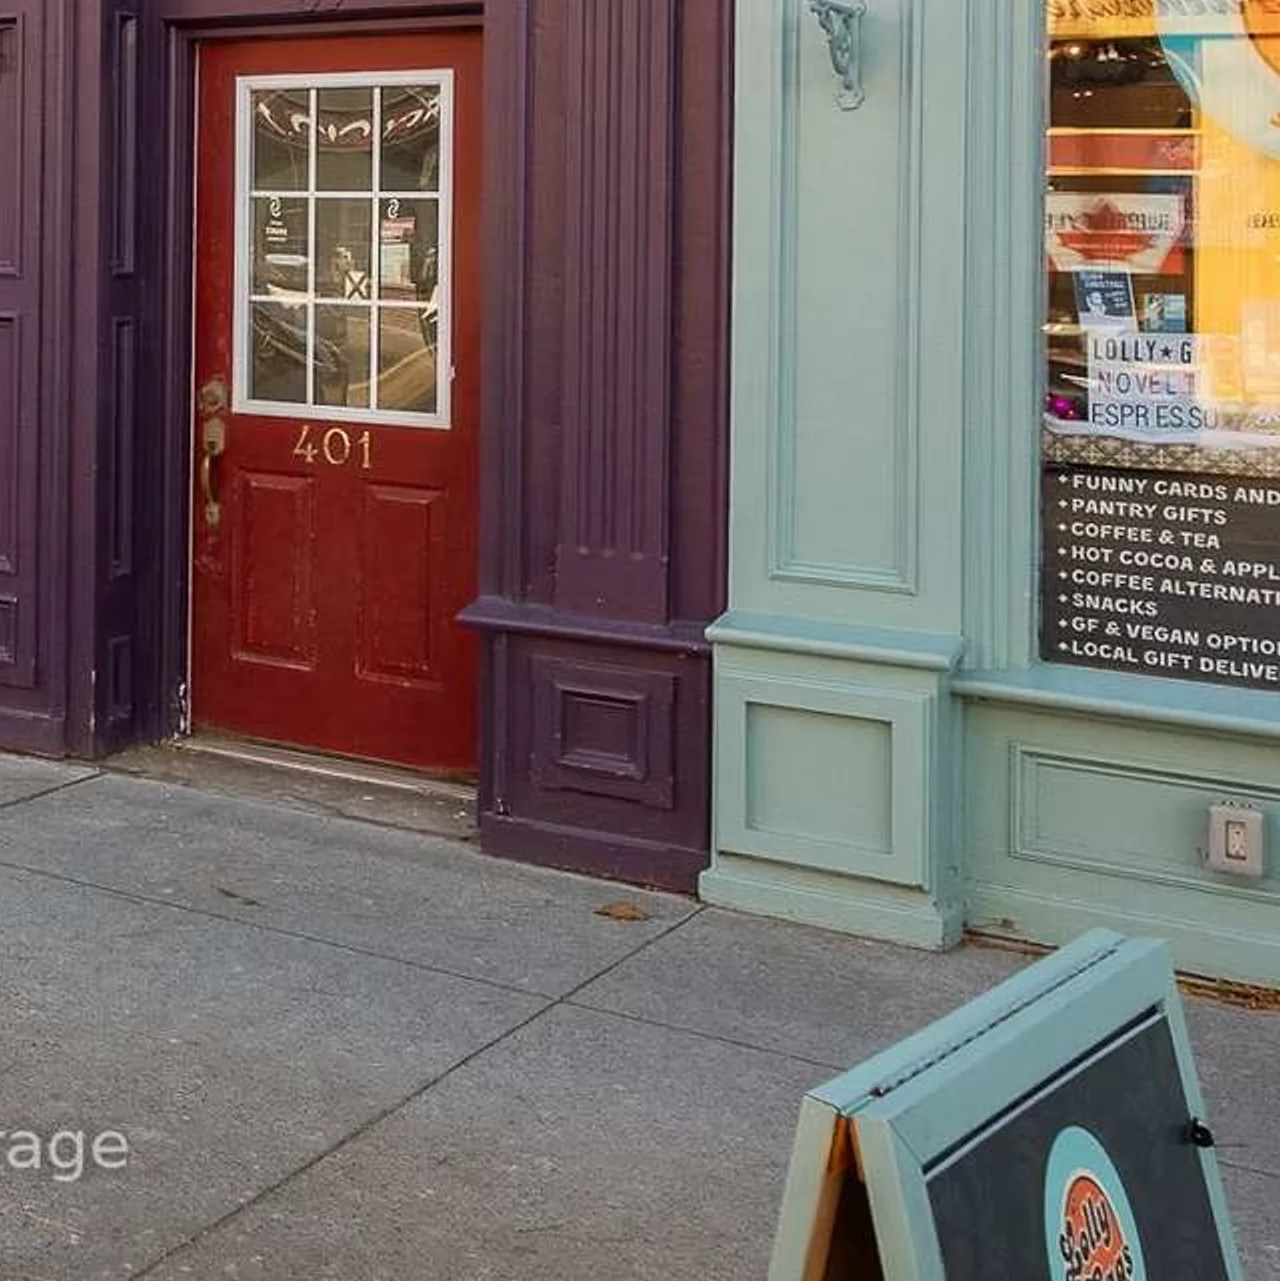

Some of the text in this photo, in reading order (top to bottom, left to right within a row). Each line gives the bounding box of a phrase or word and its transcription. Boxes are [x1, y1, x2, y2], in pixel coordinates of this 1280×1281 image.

[1093, 338, 1157, 363] LOLLY
[292, 425, 371, 468] 401
[1072, 474, 1280, 506] FUNNY CARDS AND
[1071, 499, 1228, 526] PANTRY GIFTS
[1071, 522, 1220, 550] COFFEE & TEA
[1071, 545, 1113, 564] HOT
[1119, 550, 1193, 571] COCOA
[1199, 559, 1217, 575] &
[1071, 569, 1155, 592] COFFEE
[1071, 592, 1159, 617] SNACKS
[1071, 616, 1280, 655] GF & VEGAN OPTIO
[1071, 640, 1280, 681] LOCAL GIFT DELIVE
